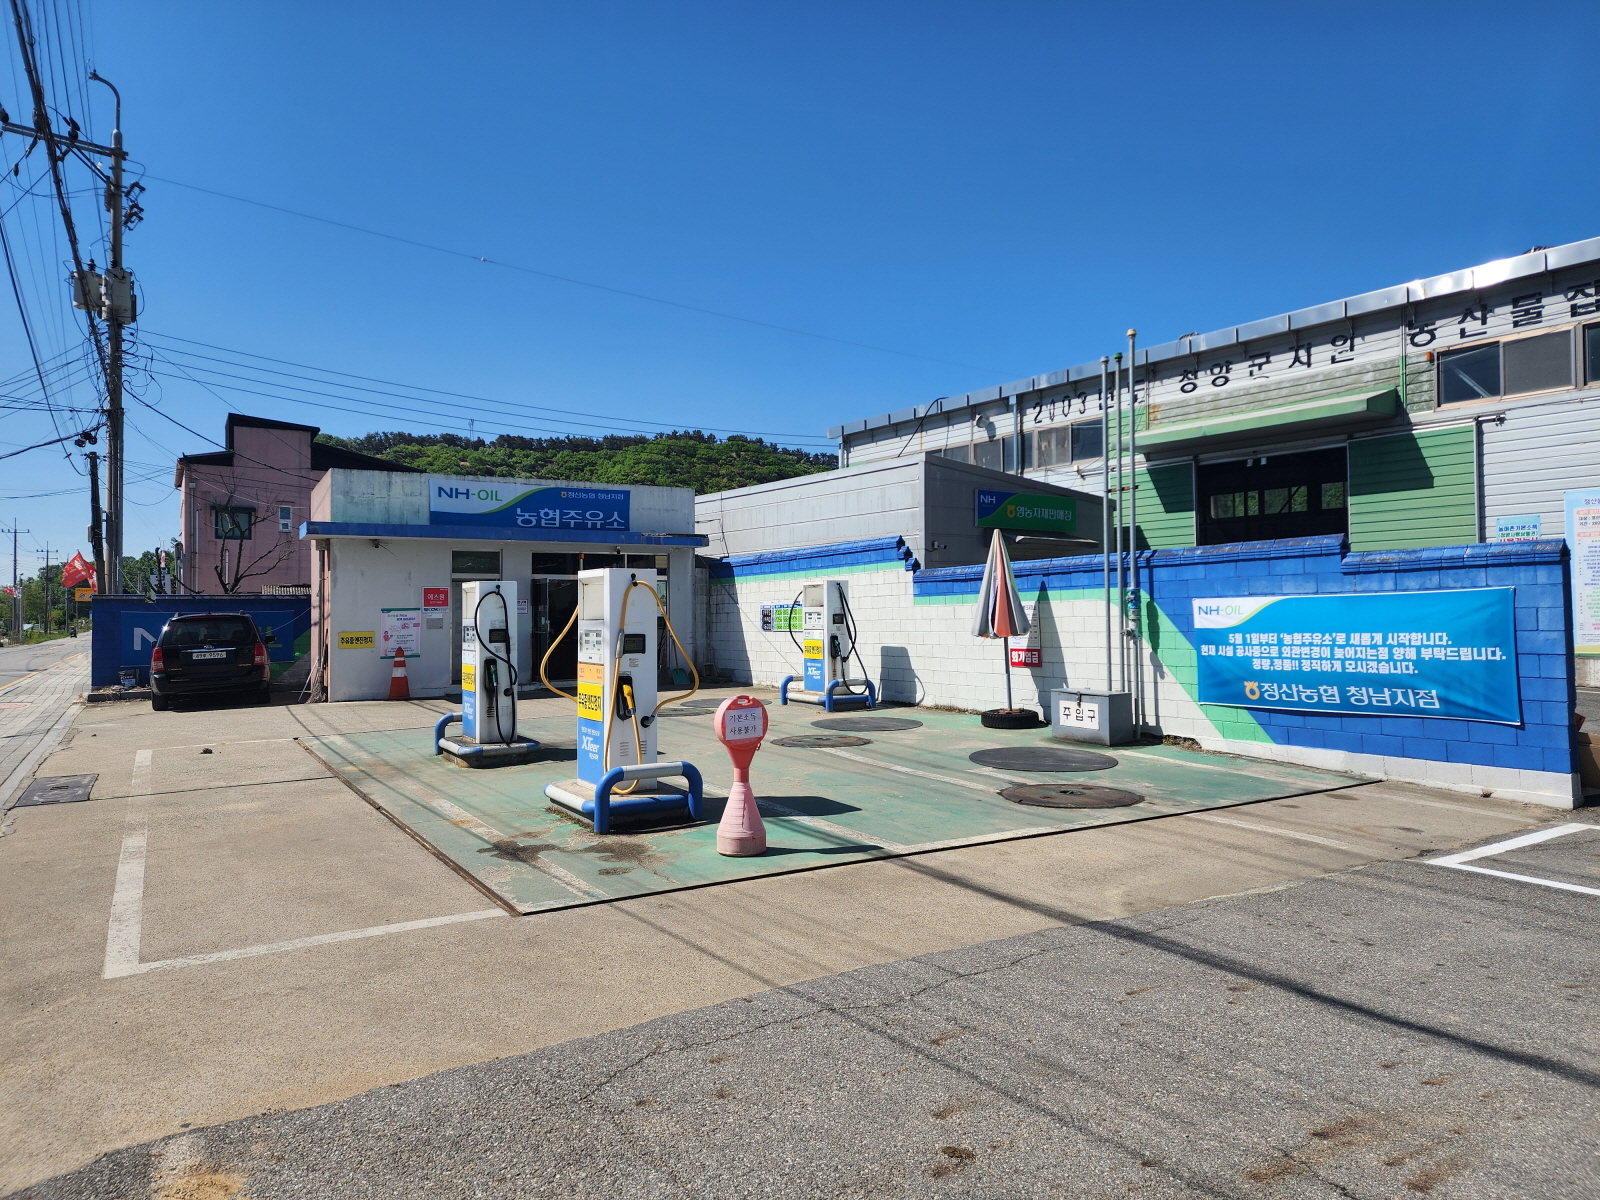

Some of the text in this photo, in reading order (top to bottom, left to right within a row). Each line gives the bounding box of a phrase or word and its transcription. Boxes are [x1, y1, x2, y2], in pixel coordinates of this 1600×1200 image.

[437, 486, 503, 502] NH-OIL
[980, 494, 996, 504] NH
[515, 507, 626, 529] 농협주유소
[1016, 505, 1073, 521] 영농자재판매장
[1197, 604, 1244, 617] NH-OIL
[1228, 632, 1243, 645] 5월
[1245, 632, 1278, 645] 1일부터
[1349, 632, 1383, 646] 새롭게
[1386, 632, 1452, 646] 시작합니다.
[1011, 650, 1039, 664] 화기엄금
[1200, 644, 1216, 656] 현재
[1218, 645, 1234, 657] 시설
[1236, 645, 1279, 658] 공사중으로
[1281, 646, 1331, 659] 외관변경이
[1392, 647, 1417, 660] 양해
[1420, 647, 1507, 661] 부탁드립니다.
[1301, 659, 1342, 672] 정직하게
[1345, 660, 1418, 674] 모시겠습니다.
[1260, 682, 1441, 709] 정산농협 청남지점
[729, 713, 757, 723] 기본소득
[1062, 706, 1096, 723] 주입구
[729, 725, 757, 735] 사용불가
[581, 735, 600, 753] XTeer
